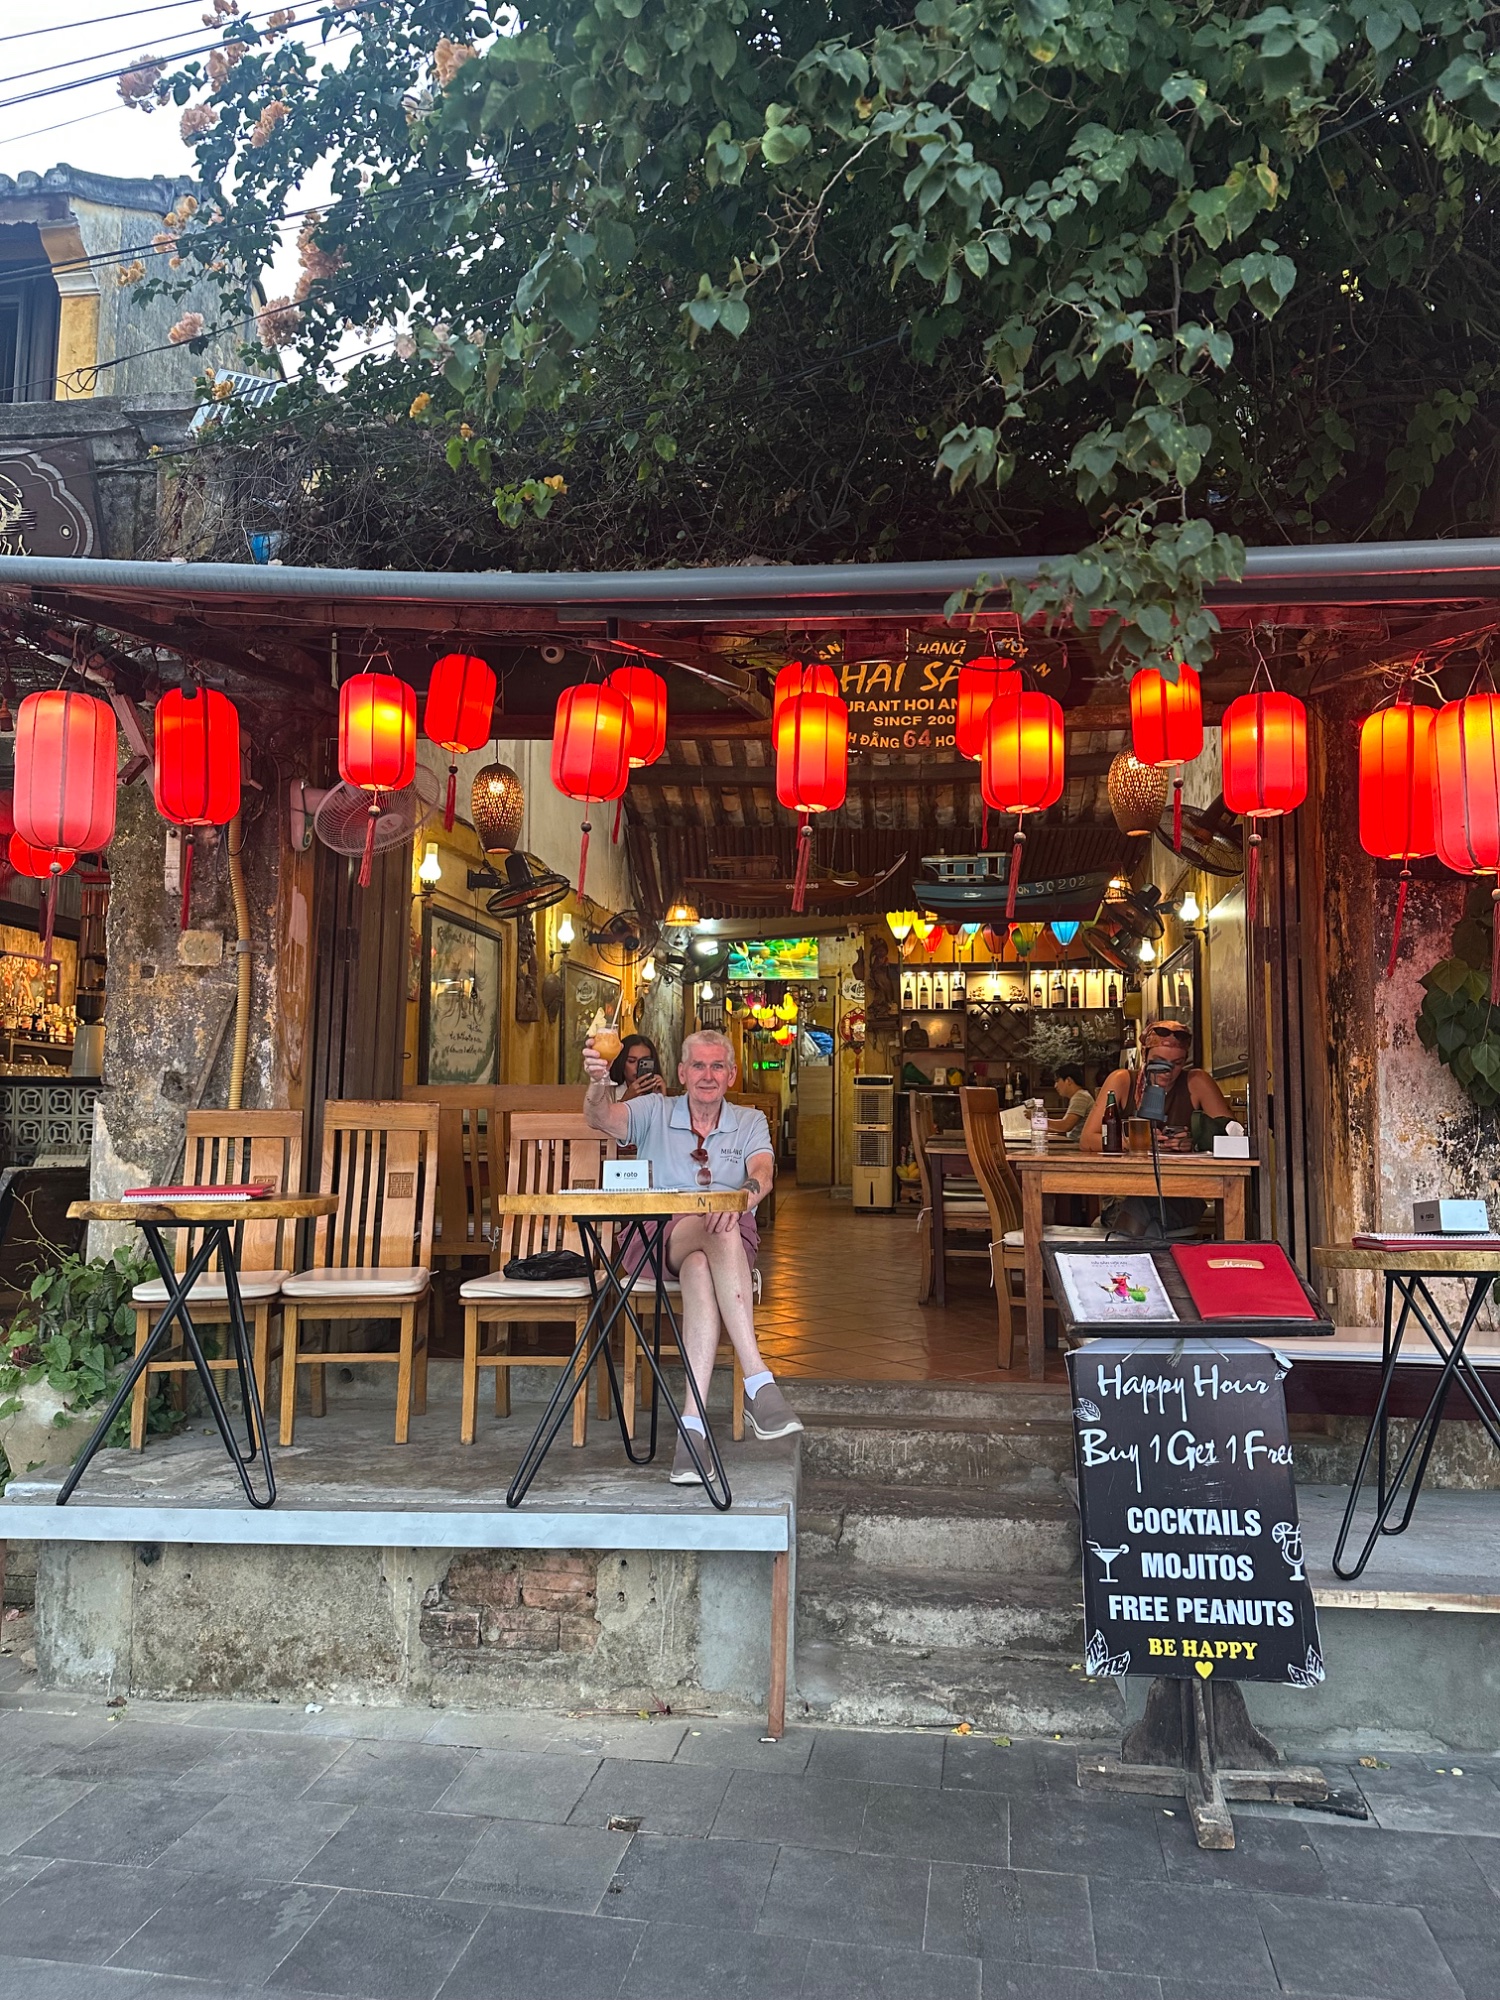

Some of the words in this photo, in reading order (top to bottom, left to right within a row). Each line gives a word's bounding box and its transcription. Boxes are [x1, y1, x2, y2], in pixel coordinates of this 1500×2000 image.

[904, 699, 934, 711] HOI
[903, 729, 931, 749] 64
[1097, 1363, 1187, 1422] Happy
[1193, 1363, 1270, 1400] Hour
[1078, 1428, 1142, 1493] Buy
[1149, 1433, 1161, 1463] 1
[1167, 1429, 1217, 1471] Get
[1226, 1434, 1237, 1464] 1
[1127, 1507, 1262, 1537] COCKTAILS
[1141, 1552, 1254, 1582] MOJITOS
[1108, 1594, 1170, 1622] FREE
[1176, 1597, 1295, 1627] PEANUTS
[1148, 1638, 1177, 1657] BE
[1181, 1639, 1258, 1660] HAPPY
